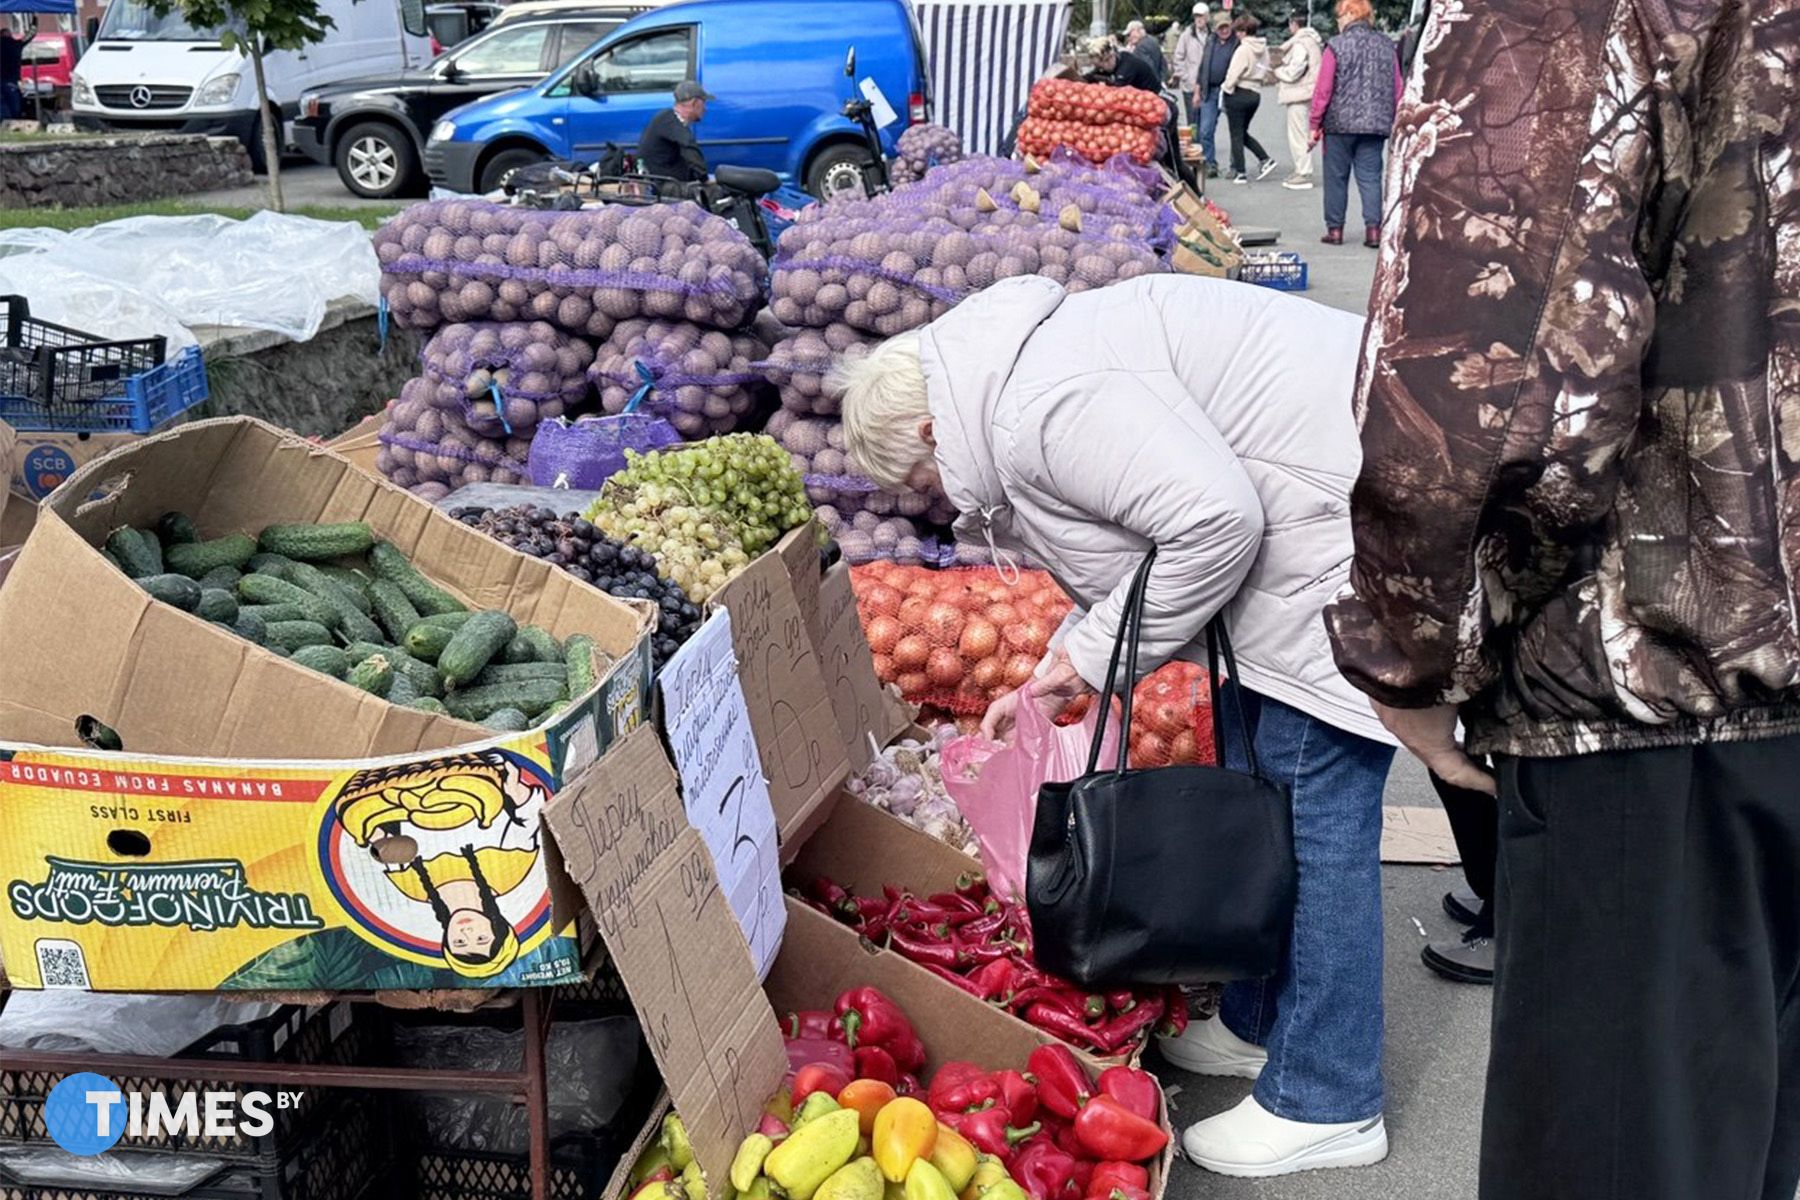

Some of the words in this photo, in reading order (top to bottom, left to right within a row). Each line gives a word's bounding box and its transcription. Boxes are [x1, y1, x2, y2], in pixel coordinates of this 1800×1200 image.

[33, 457, 66, 470] SCB
[11, 765, 100, 787] ECUADOR
[115, 775, 169, 791] FROM
[183, 780, 282, 796] BANANAS
[90, 805, 139, 820] CLASS
[147, 808, 191, 823] FIRST
[571, 784, 646, 884] Перец
[128, 870, 250, 900] Premium
[12, 884, 320, 930] TRIVIÑOFOODS
[521, 971, 555, 981] WEIGHT
[556, 966, 572, 977] NET
